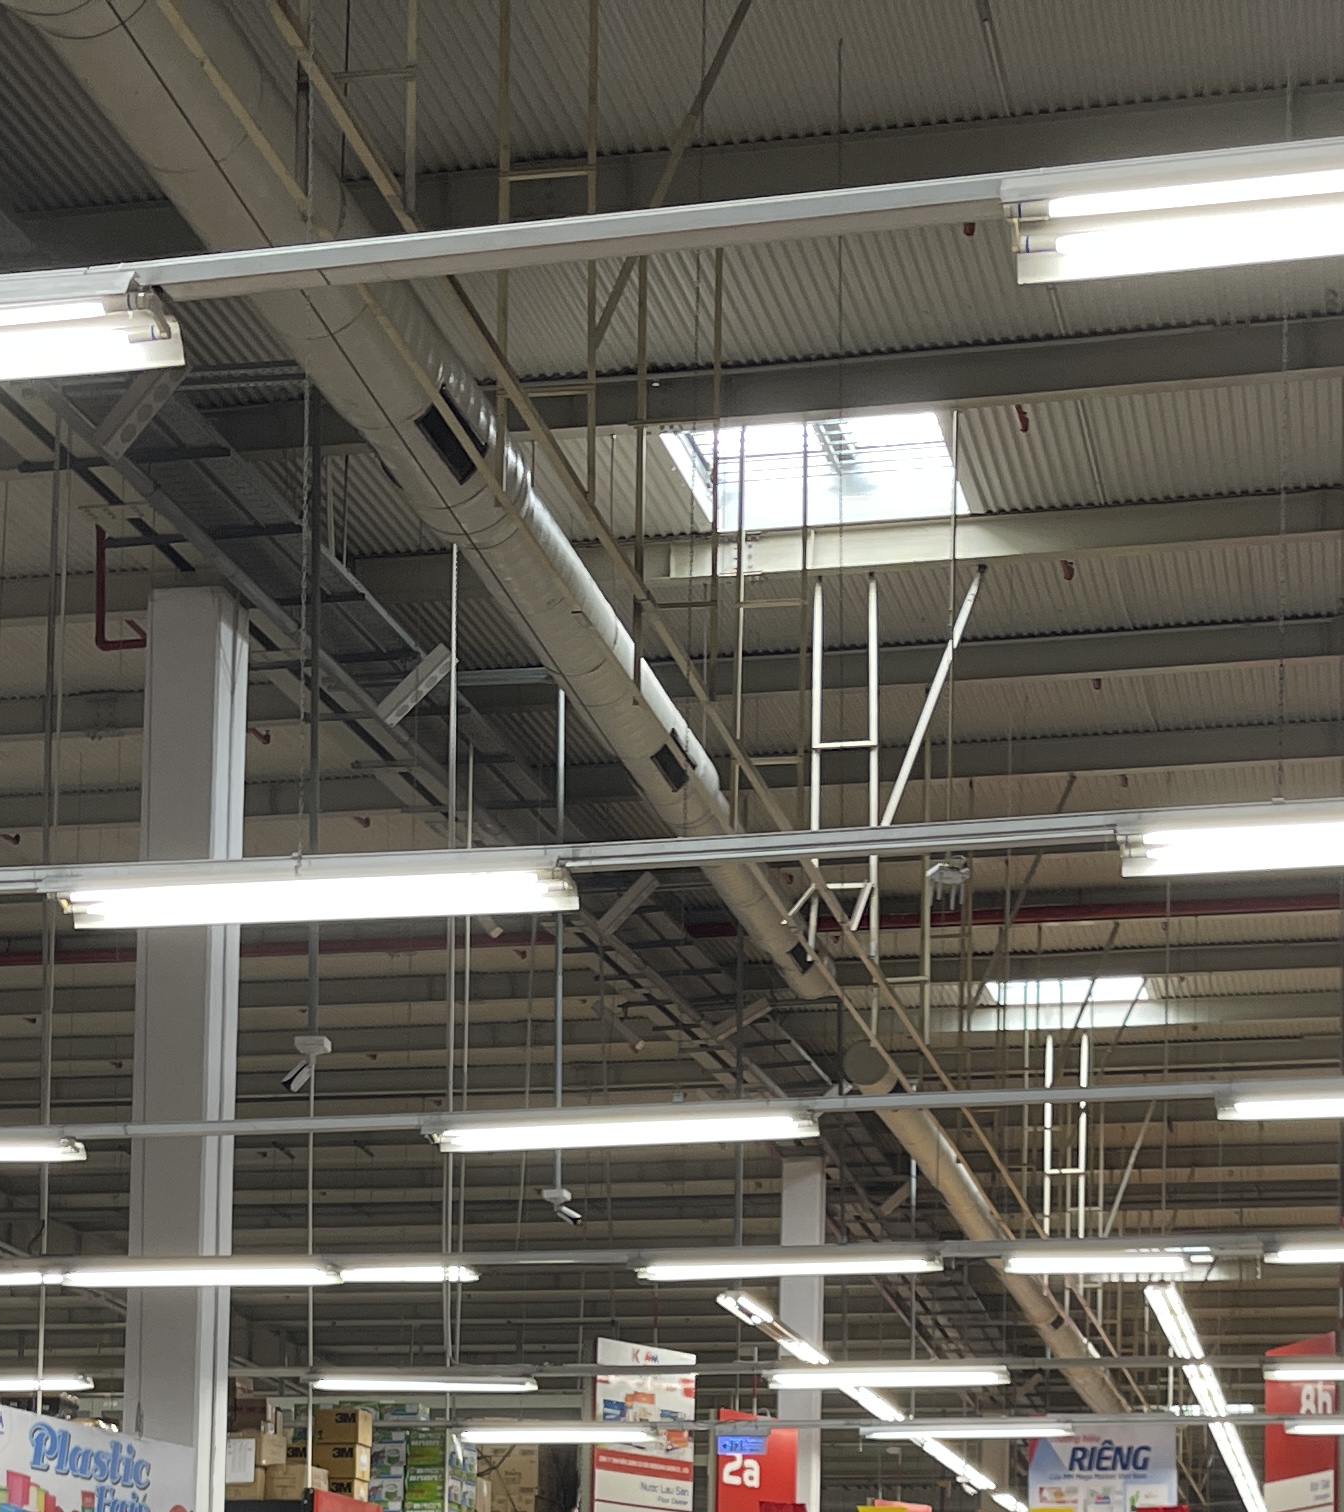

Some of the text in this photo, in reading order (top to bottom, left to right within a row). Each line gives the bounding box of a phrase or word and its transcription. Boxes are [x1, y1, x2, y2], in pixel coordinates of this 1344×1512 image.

[28, 1421, 152, 1490] Plastic
[722, 1453, 761, 1489] 2a
[1068, 1439, 1152, 1472] RIÊNG
